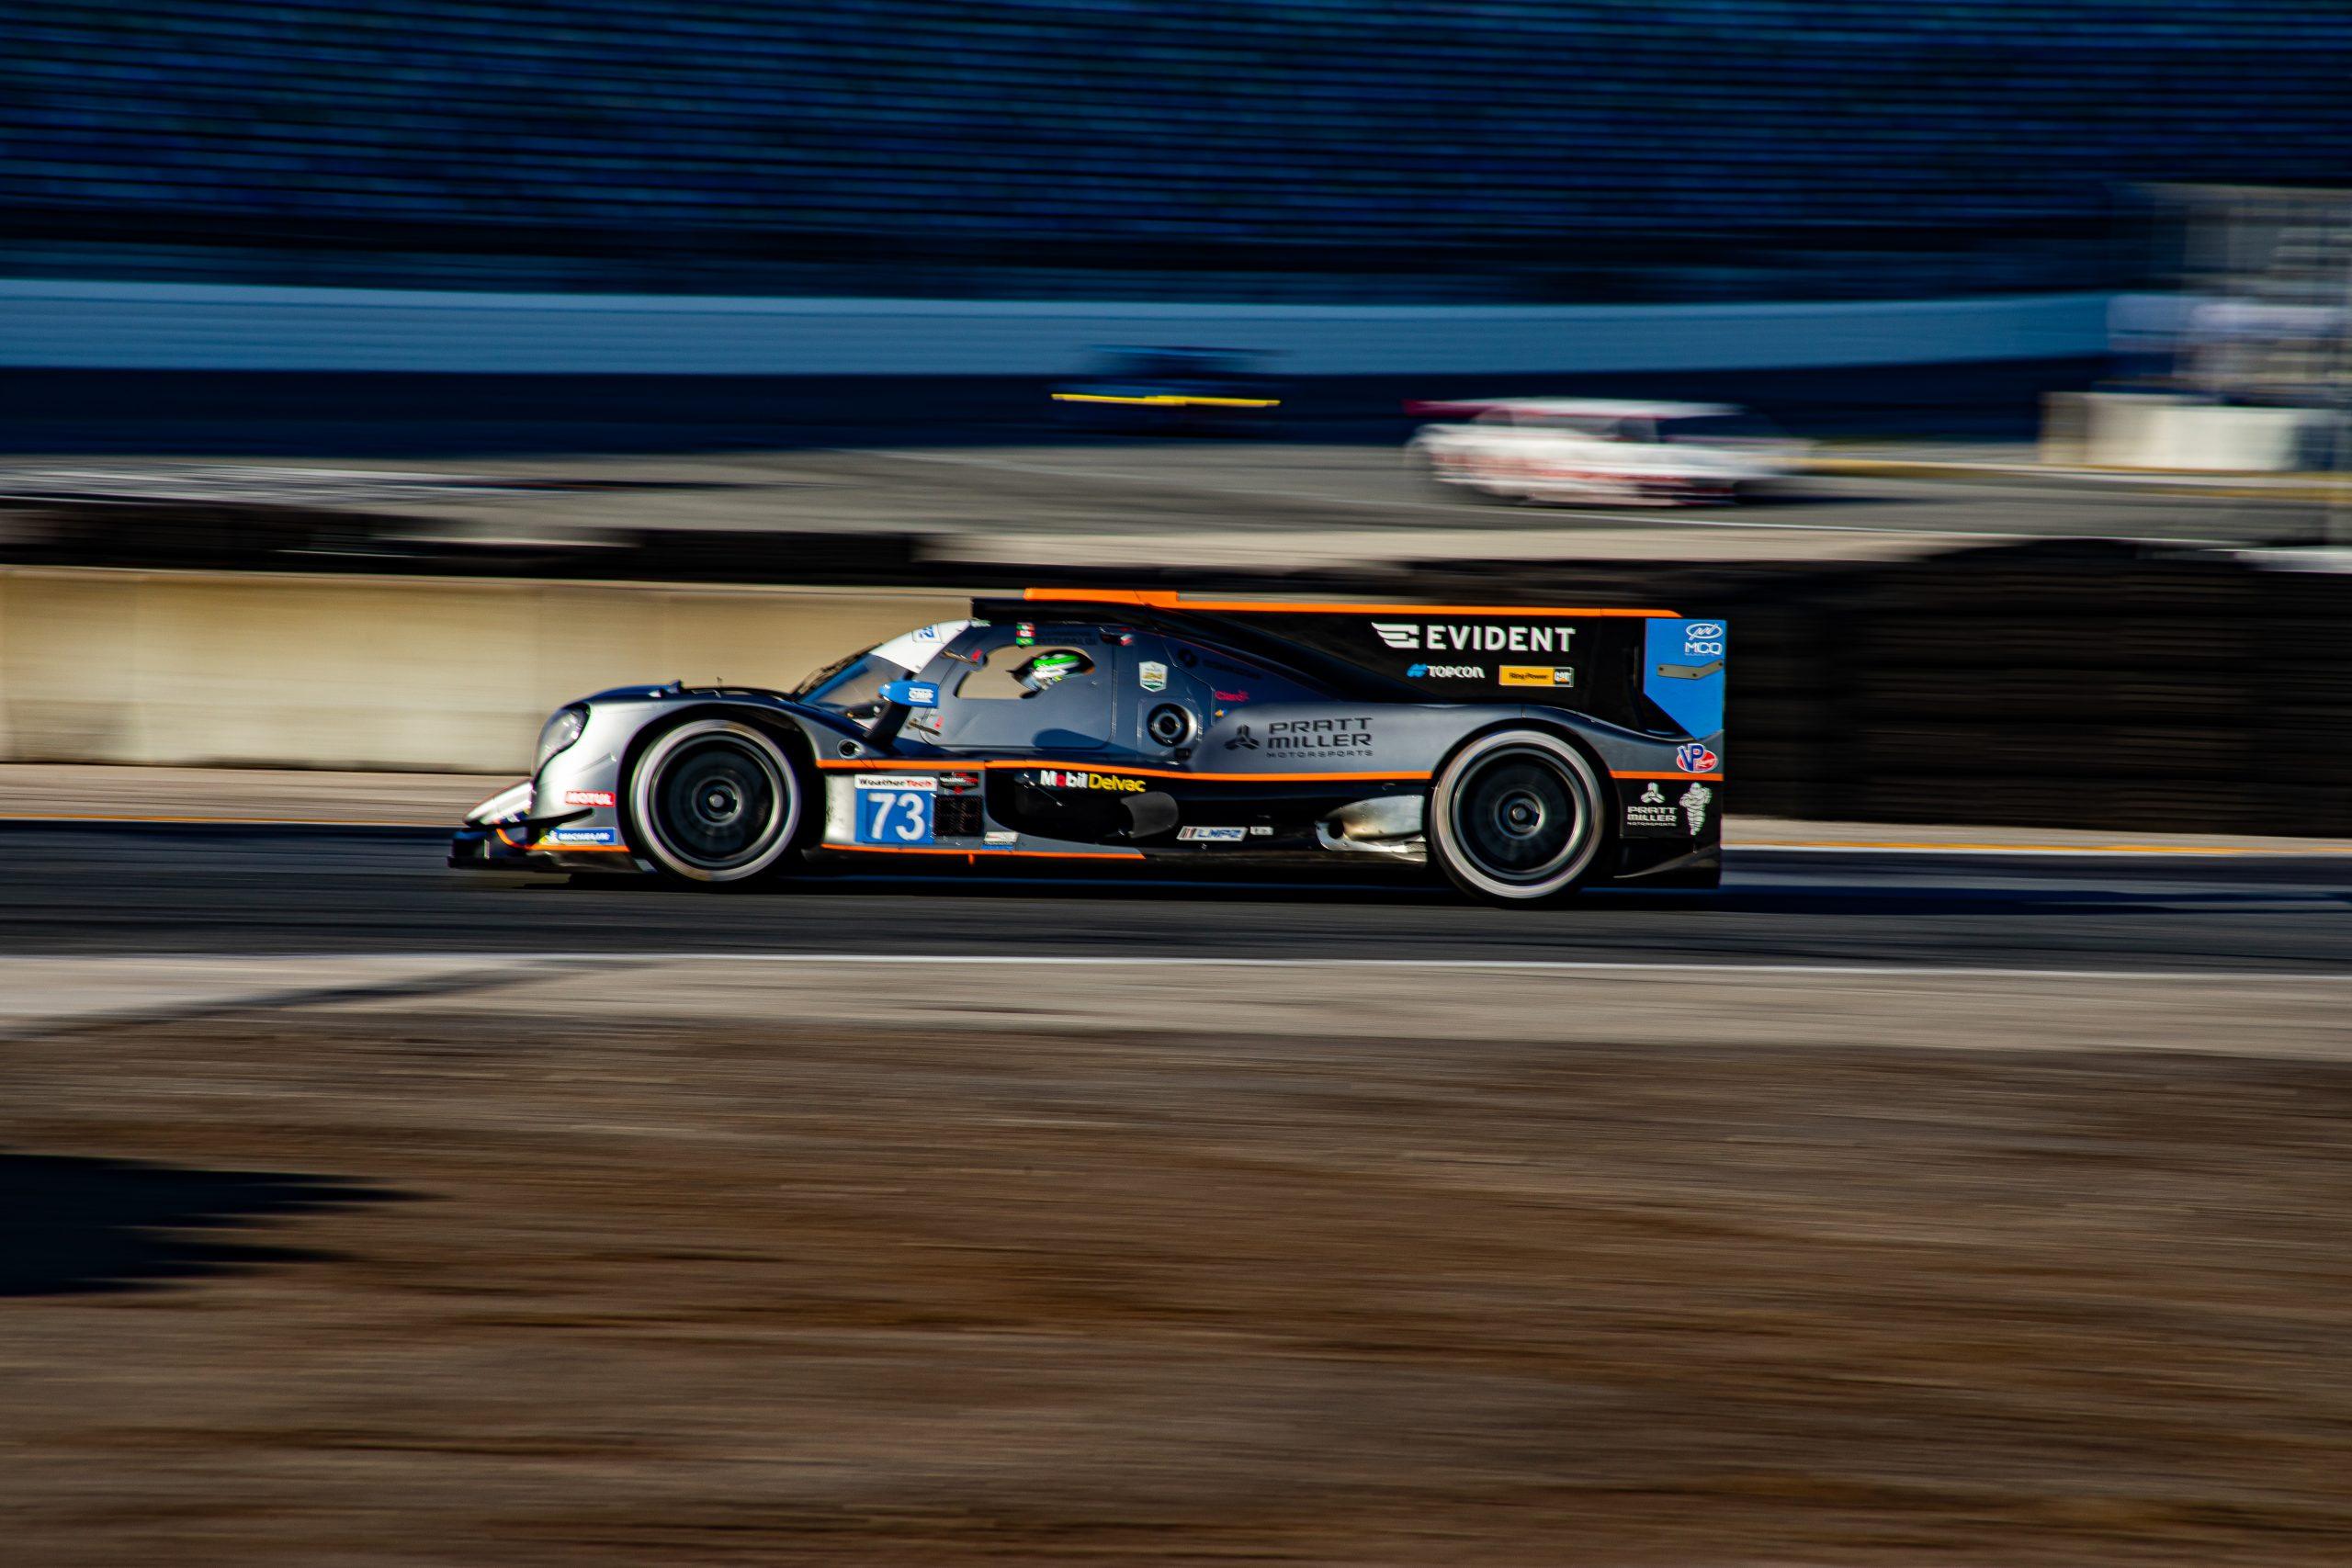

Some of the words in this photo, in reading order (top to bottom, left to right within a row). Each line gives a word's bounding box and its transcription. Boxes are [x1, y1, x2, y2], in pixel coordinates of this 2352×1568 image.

[1427, 625, 1577, 652] EVIDENT
[1684, 641, 1723, 655] MCQ
[1428, 665, 1486, 679] TOPCON
[1268, 716, 1374, 735] PRATT
[1267, 733, 1373, 750] MILLER
[1266, 750, 1374, 759] MOTORSPORTS
[1678, 742, 1704, 772] VP
[1040, 770, 1088, 789] Mobil
[1088, 773, 1147, 793] Delvac
[867, 792, 926, 841] 73
[1627, 807, 1678, 815] PRATT
[1627, 814, 1678, 822] MILLER
